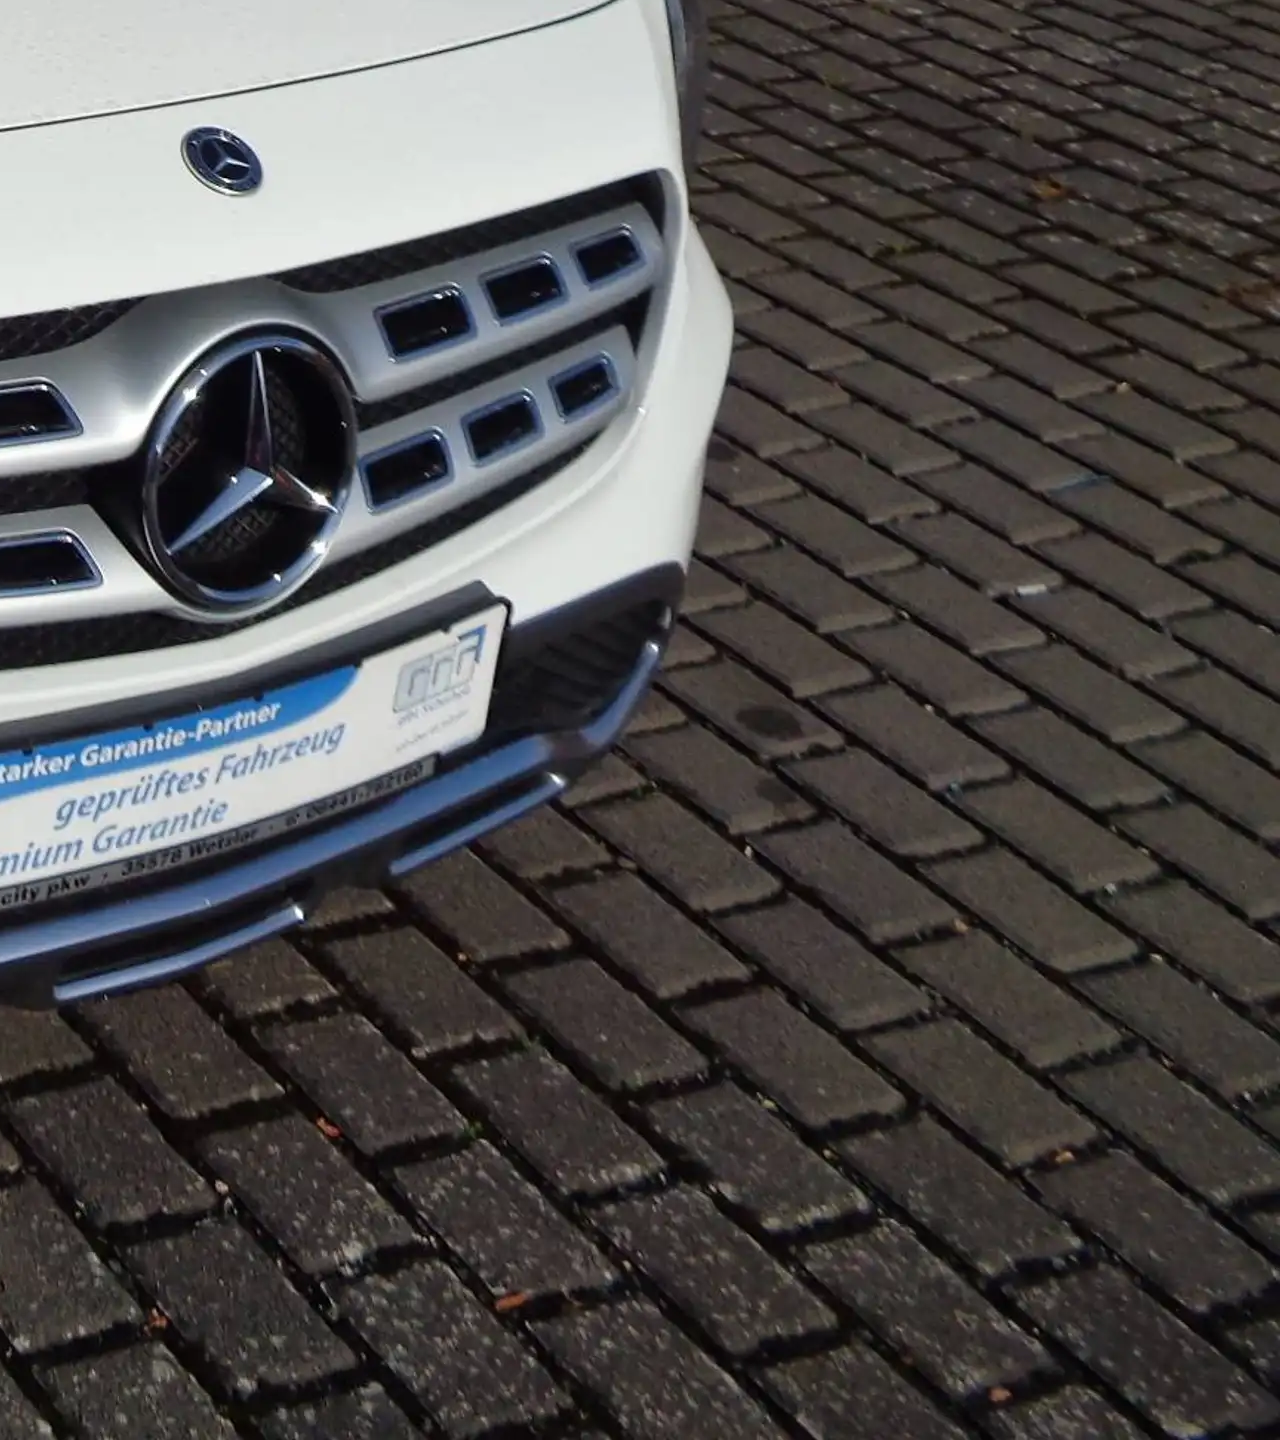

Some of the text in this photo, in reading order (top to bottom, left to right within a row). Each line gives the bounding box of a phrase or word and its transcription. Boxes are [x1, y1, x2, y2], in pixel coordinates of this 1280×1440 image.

[80, 702, 281, 767] Garantie-Partner
[53, 766, 209, 831] geprüftes
[214, 722, 346, 785] Fahrzeug
[92, 798, 229, 854] Garantie
[0, 885, 40, 906] city
[45, 872, 91, 898] pkw
